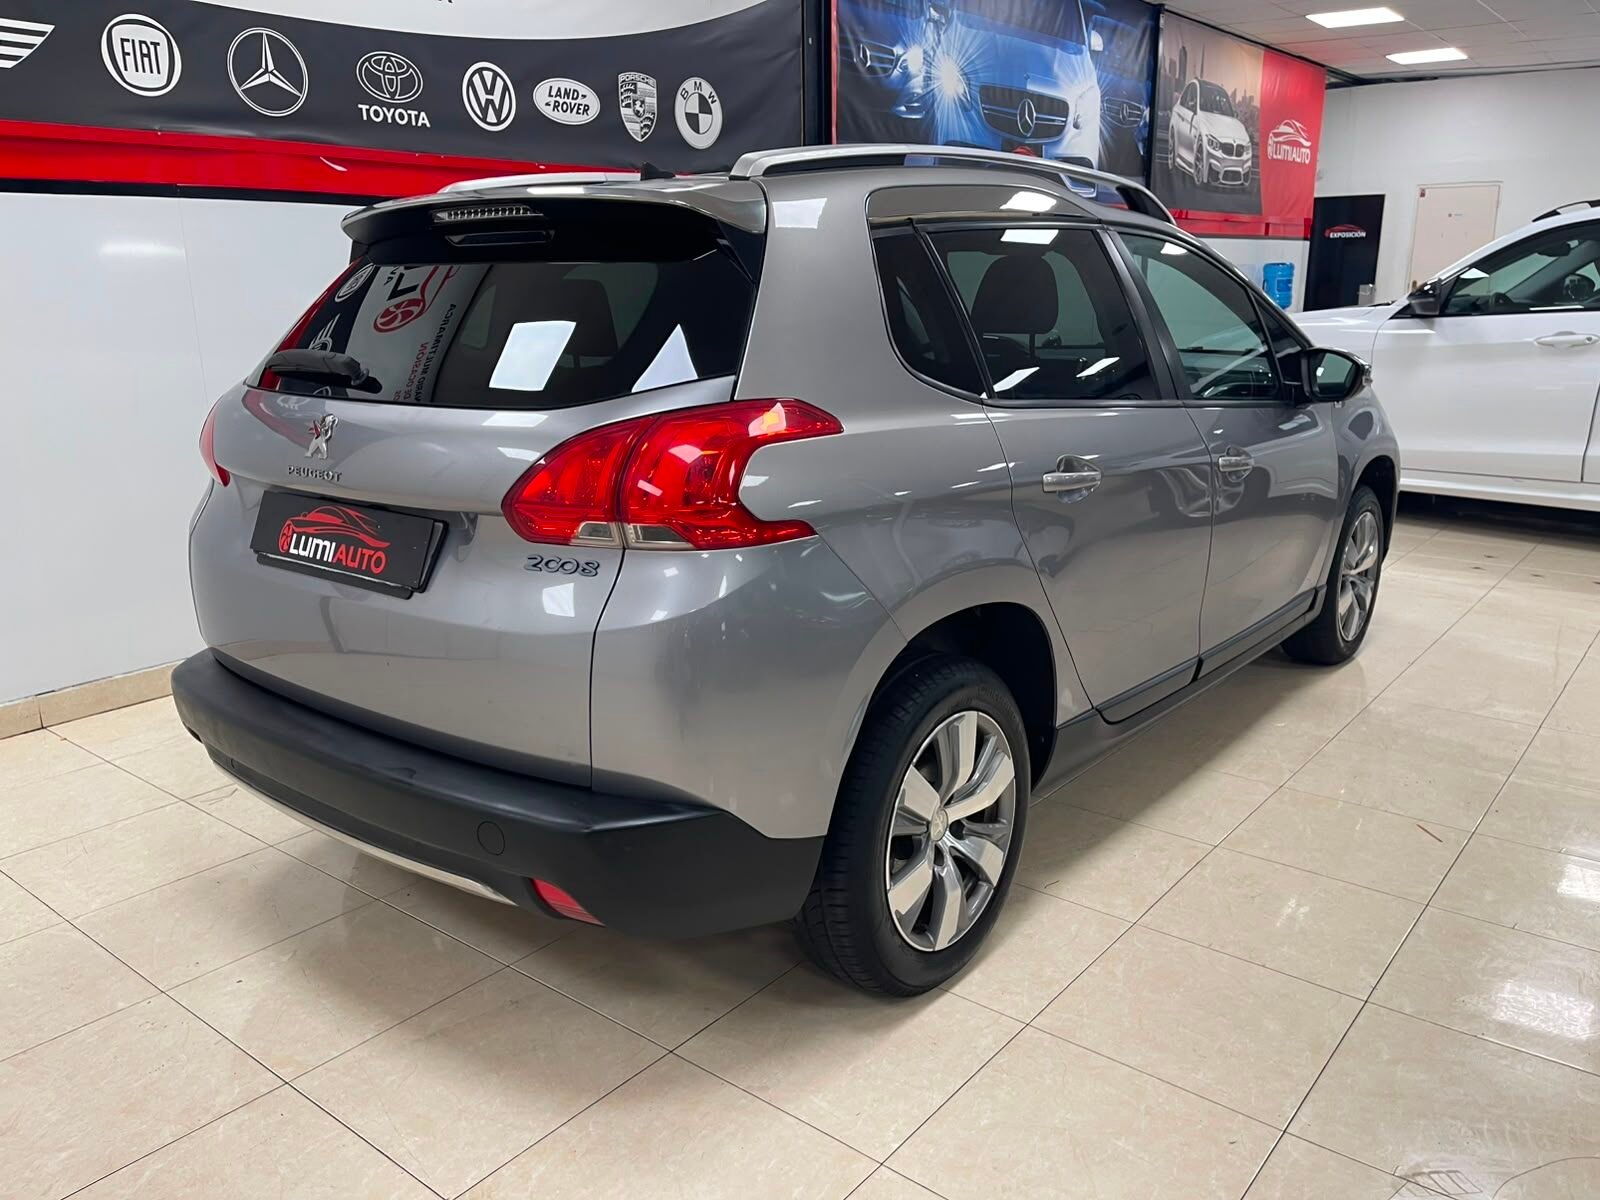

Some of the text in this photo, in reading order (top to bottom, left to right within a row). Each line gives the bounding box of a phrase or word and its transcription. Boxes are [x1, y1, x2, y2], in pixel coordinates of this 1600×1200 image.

[120, 37, 161, 75] FIAT
[620, 74, 656, 88] PORSCHE
[680, 81, 716, 104] BMW
[358, 104, 430, 127] TOYOTA
[1272, 147, 1311, 164] LUMIAUTO
[288, 466, 342, 482] PEUGEOT
[289, 533, 386, 574] LUMIAUTO
[524, 554, 600, 577] 2008
